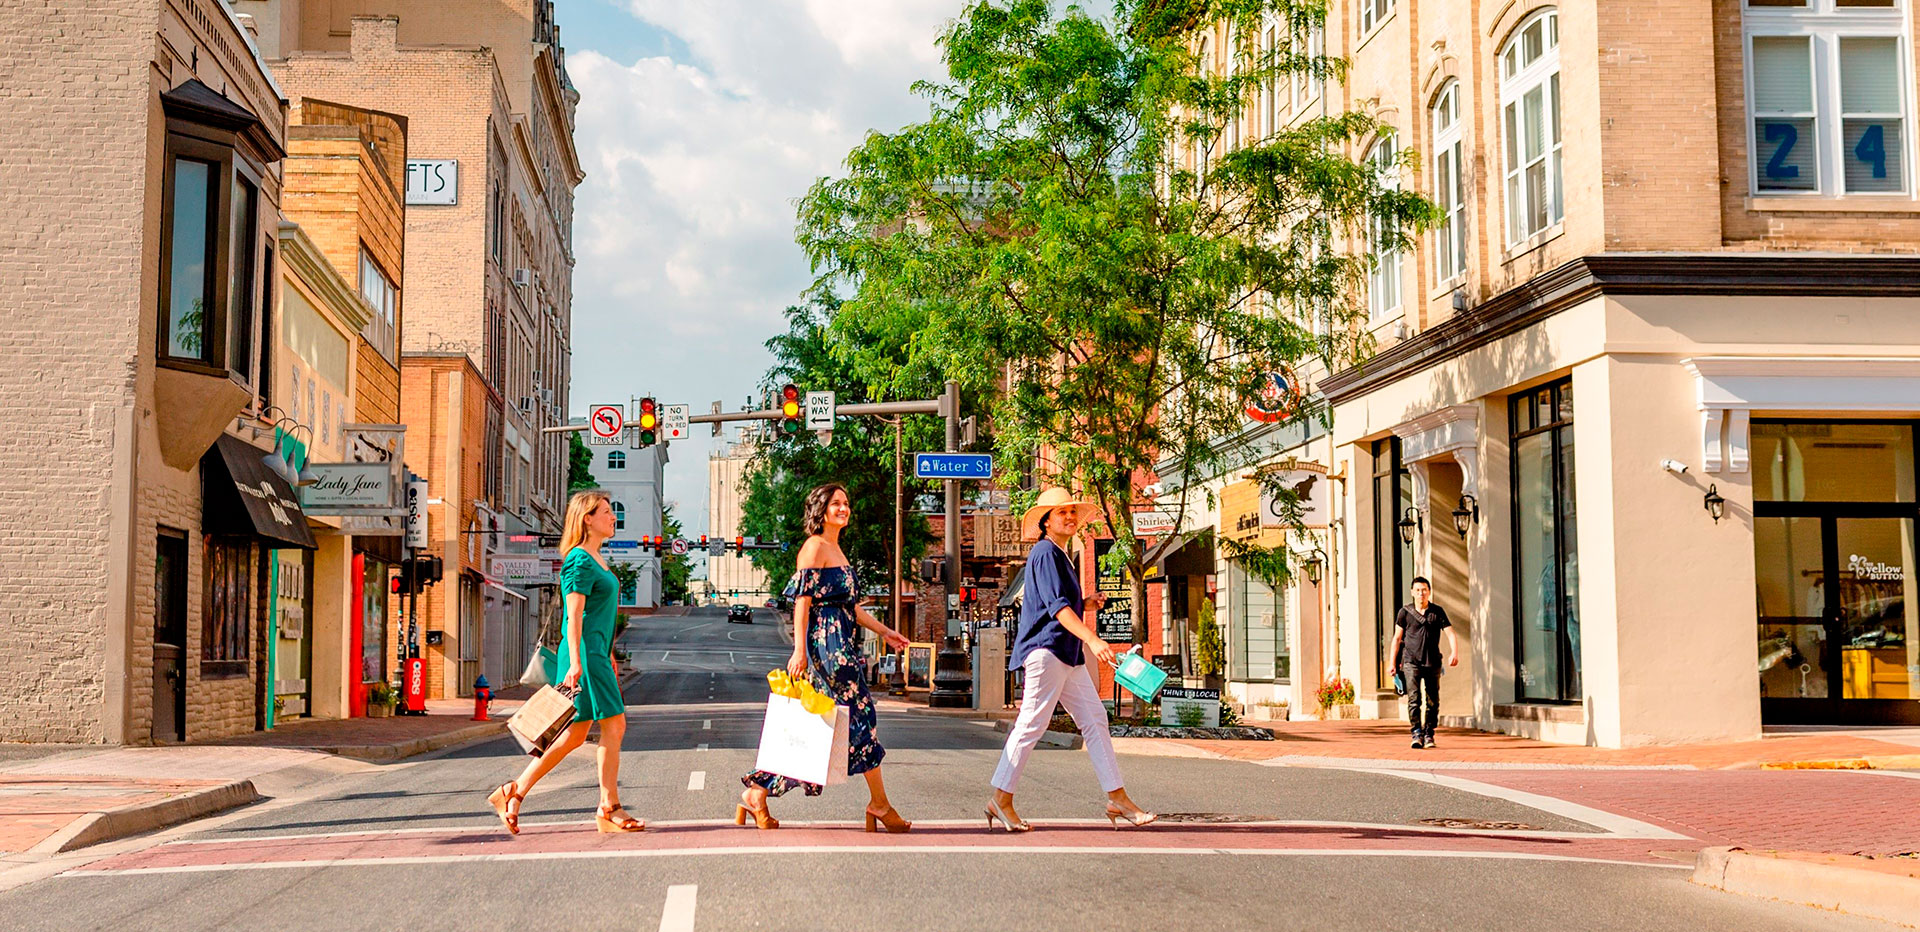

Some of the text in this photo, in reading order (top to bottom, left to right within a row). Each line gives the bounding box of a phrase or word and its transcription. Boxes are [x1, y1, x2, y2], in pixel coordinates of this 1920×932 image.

[1765, 123, 1887, 178] 2 4
[811, 397, 829, 405] ONE
[811, 407, 830, 415] WAY
[594, 436, 620, 444] TRUCKS
[932, 459, 990, 472] Water St
[309, 474, 382, 496] Lady Jane
[1866, 563, 1901, 577] yellow
[412, 661, 421, 695] oasis
[1163, 689, 1184, 697] THINK
